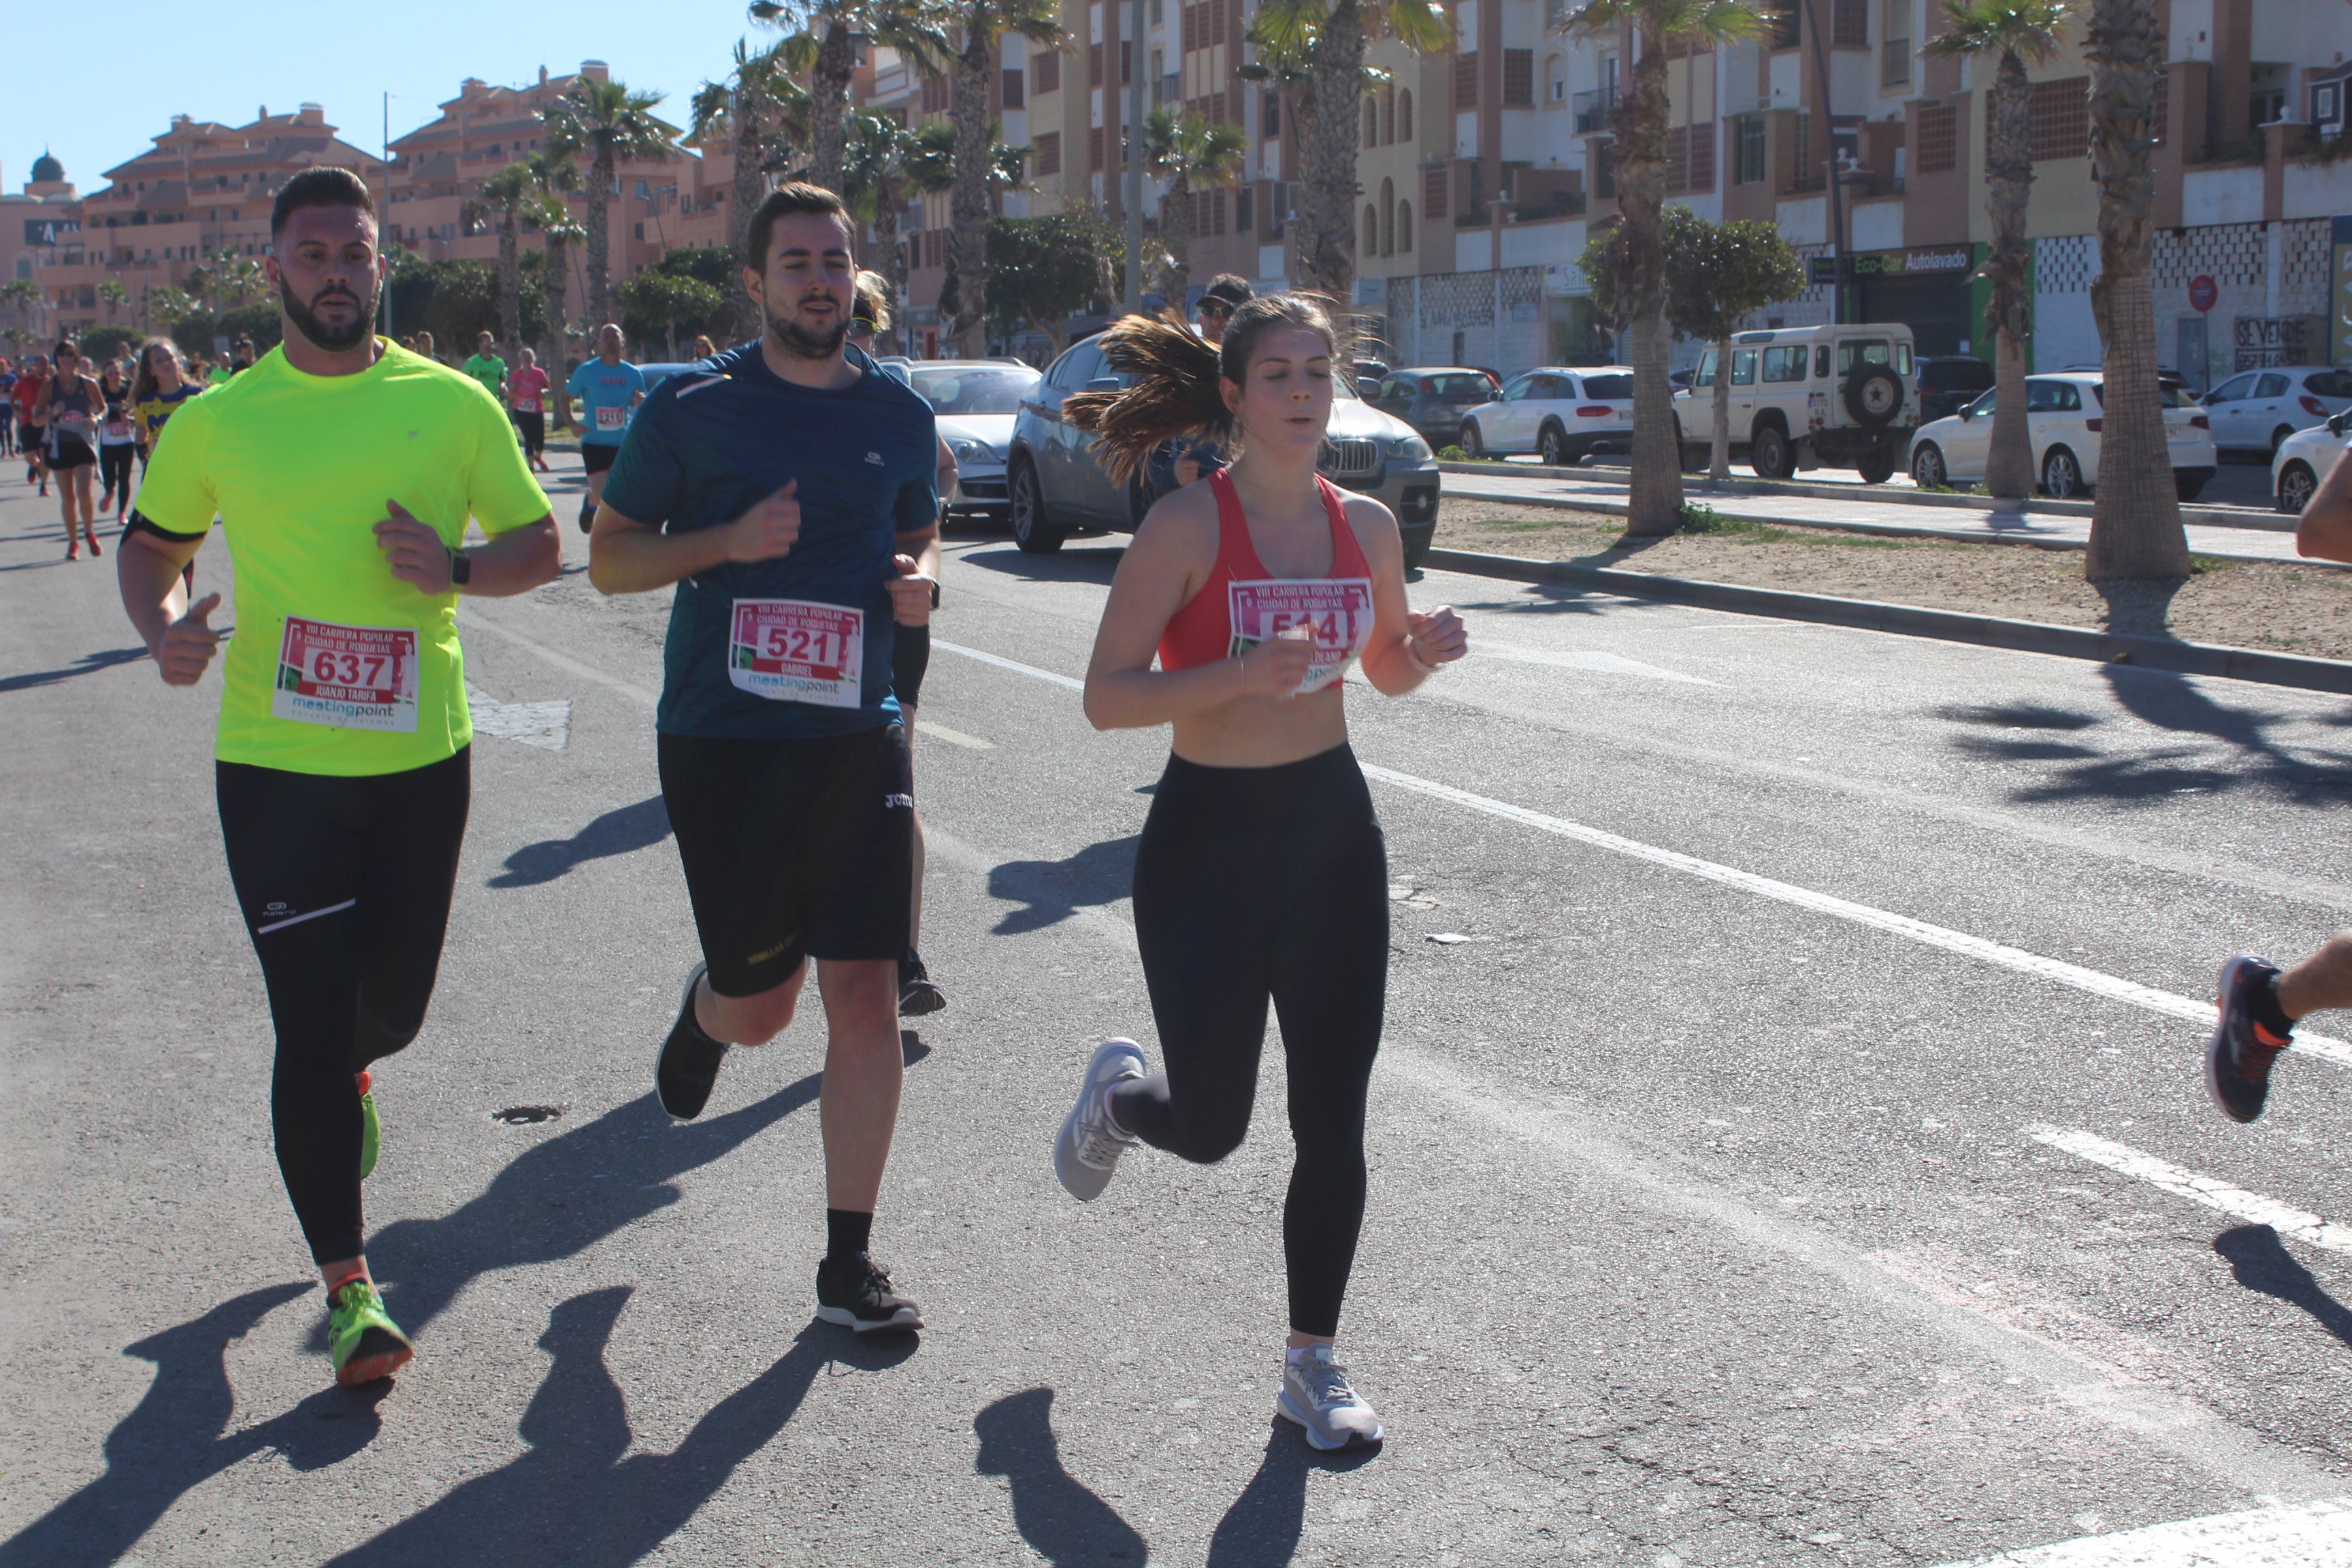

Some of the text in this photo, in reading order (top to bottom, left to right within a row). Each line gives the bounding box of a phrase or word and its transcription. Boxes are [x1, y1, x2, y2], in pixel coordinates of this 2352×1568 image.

[1855, 254, 1903, 274] Eco-Car
[1905, 249, 1966, 271] Autolavado
[772, 605, 808, 617] CARRERA
[810, 609, 843, 621] POPULAR
[307, 623, 393, 642] VIII CARRERA POPULAR
[305, 636, 391, 654] CIUDAD DE ROQUETAS
[767, 628, 828, 662] 521
[314, 651, 386, 687] 637
[781, 662, 812, 677] GABRIEL
[749, 674, 840, 693] meetingpoint
[316, 685, 376, 702] JUANJO TARIFA
[293, 698, 395, 717] meetingpoint
